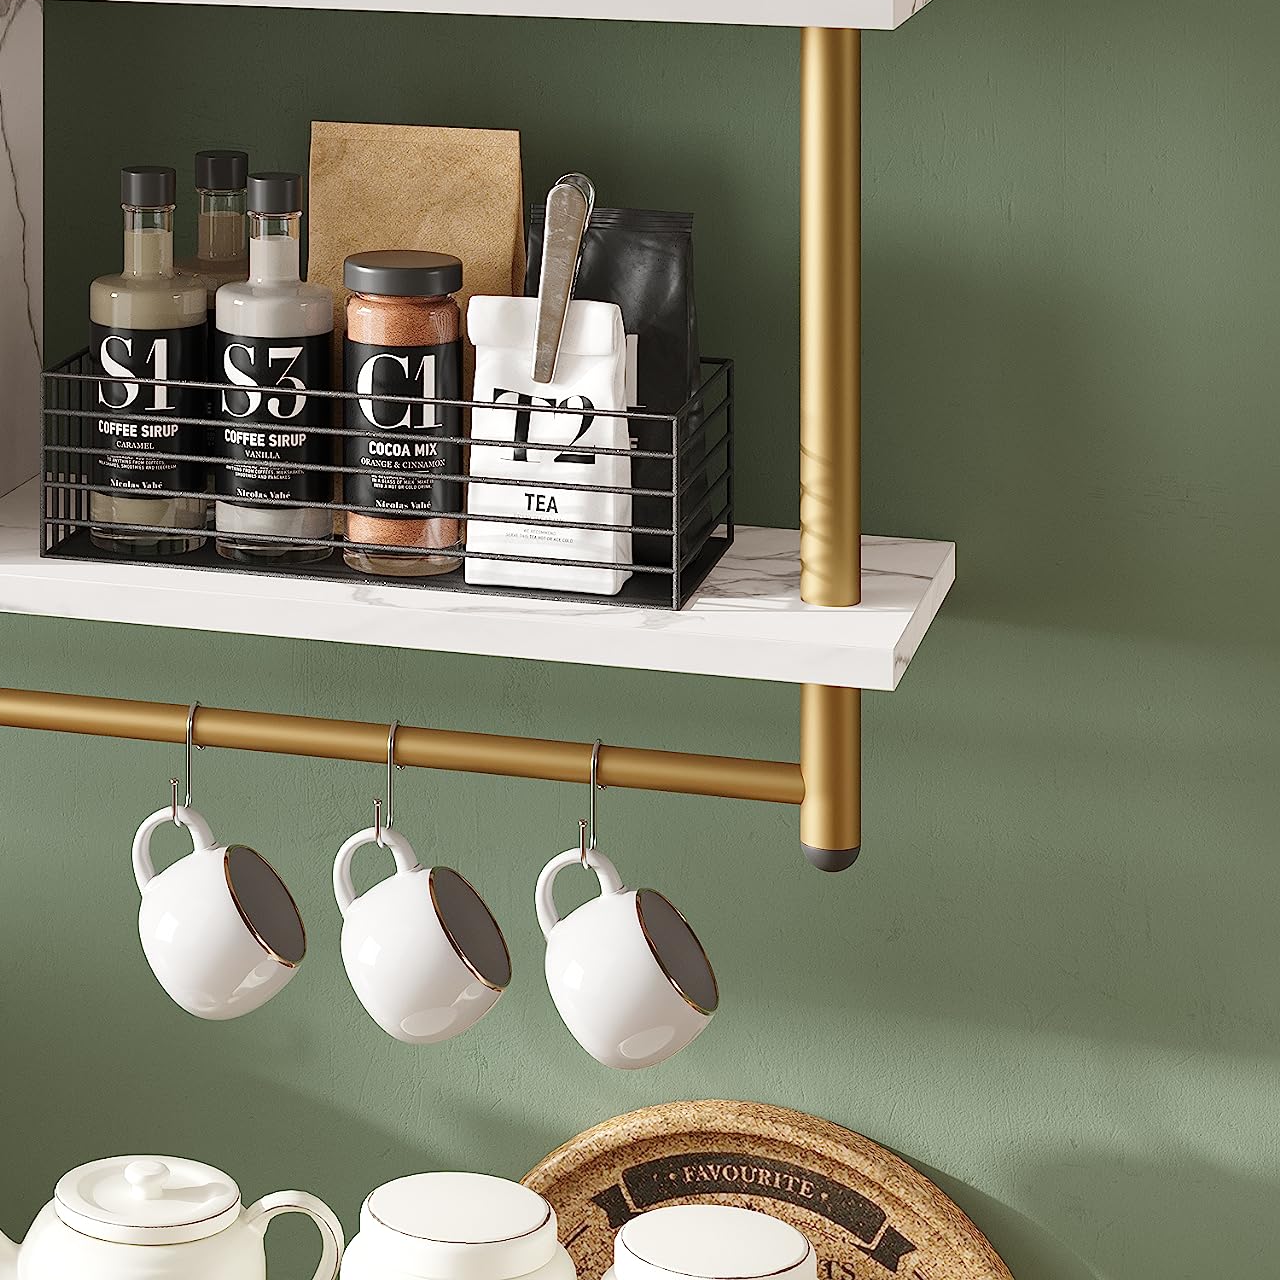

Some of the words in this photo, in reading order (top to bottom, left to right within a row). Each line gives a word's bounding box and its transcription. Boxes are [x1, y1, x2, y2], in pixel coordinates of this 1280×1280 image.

[99, 335, 176, 411] S1
[222, 343, 307, 419] S3
[357, 353, 443, 429] C1
[98, 419, 138, 437] COFFEE
[141, 424, 179, 438] SIRUP
[493, 387, 596, 465] T2
[116, 440, 155, 450] CARAMEL
[224, 428, 266, 447] COFFEE
[268, 433, 307, 447] SIRUP
[245, 449, 280, 459] VANILLA
[368, 440, 411, 457] COCOA
[414, 442, 438, 457] MIX
[360, 457, 393, 467] ORANGE
[394, 461, 400, 469] &
[402, 458, 446, 469] CINNAMON
[110, 478, 140, 489] Nicolas
[142, 481, 164, 489] Vahé
[236, 487, 268, 499] Nicolas
[269, 490, 291, 500] Vahé
[524, 492, 559, 514] TEA
[375, 499, 409, 509] Nicolas
[410, 501, 432, 509] Vahé
[682, 1163, 816, 1200] FAVOURITE
